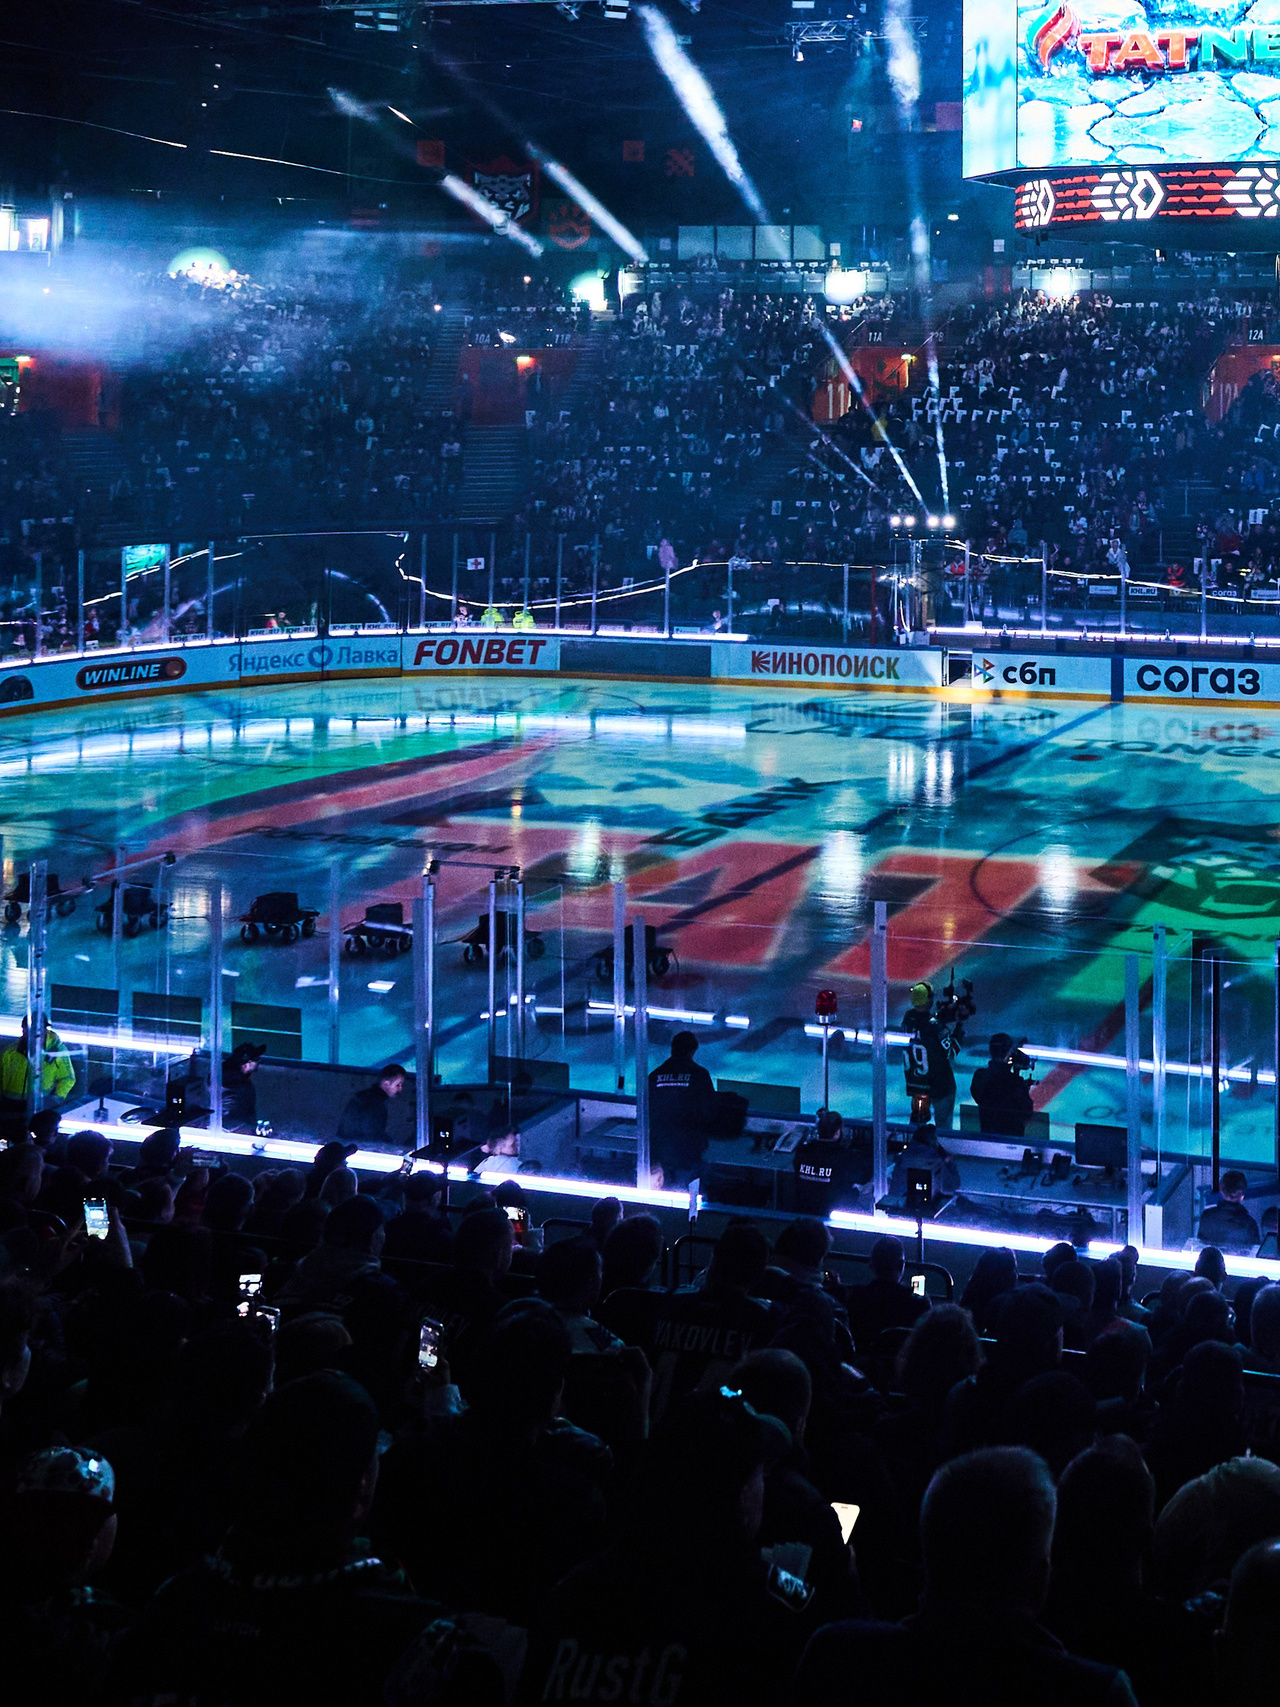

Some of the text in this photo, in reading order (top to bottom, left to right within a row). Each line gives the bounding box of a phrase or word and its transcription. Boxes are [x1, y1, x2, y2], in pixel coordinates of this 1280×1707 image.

[868, 331, 883, 343] 11A
[1248, 329, 1265, 341] 12A
[1130, 587, 1157, 596] KHL.RU
[228, 645, 399, 673] Яндекс Лавка
[413, 639, 547, 666] FONBET
[85, 663, 162, 685] WINLINE
[751, 650, 901, 681] КИНОПОИСК
[1002, 661, 1057, 686] сбп
[1136, 664, 1261, 695] согаз
[656, 1073, 692, 1083] KHL.RU
[798, 1163, 833, 1177] KHL.RU
[540, 1637, 688, 1707] RustG
